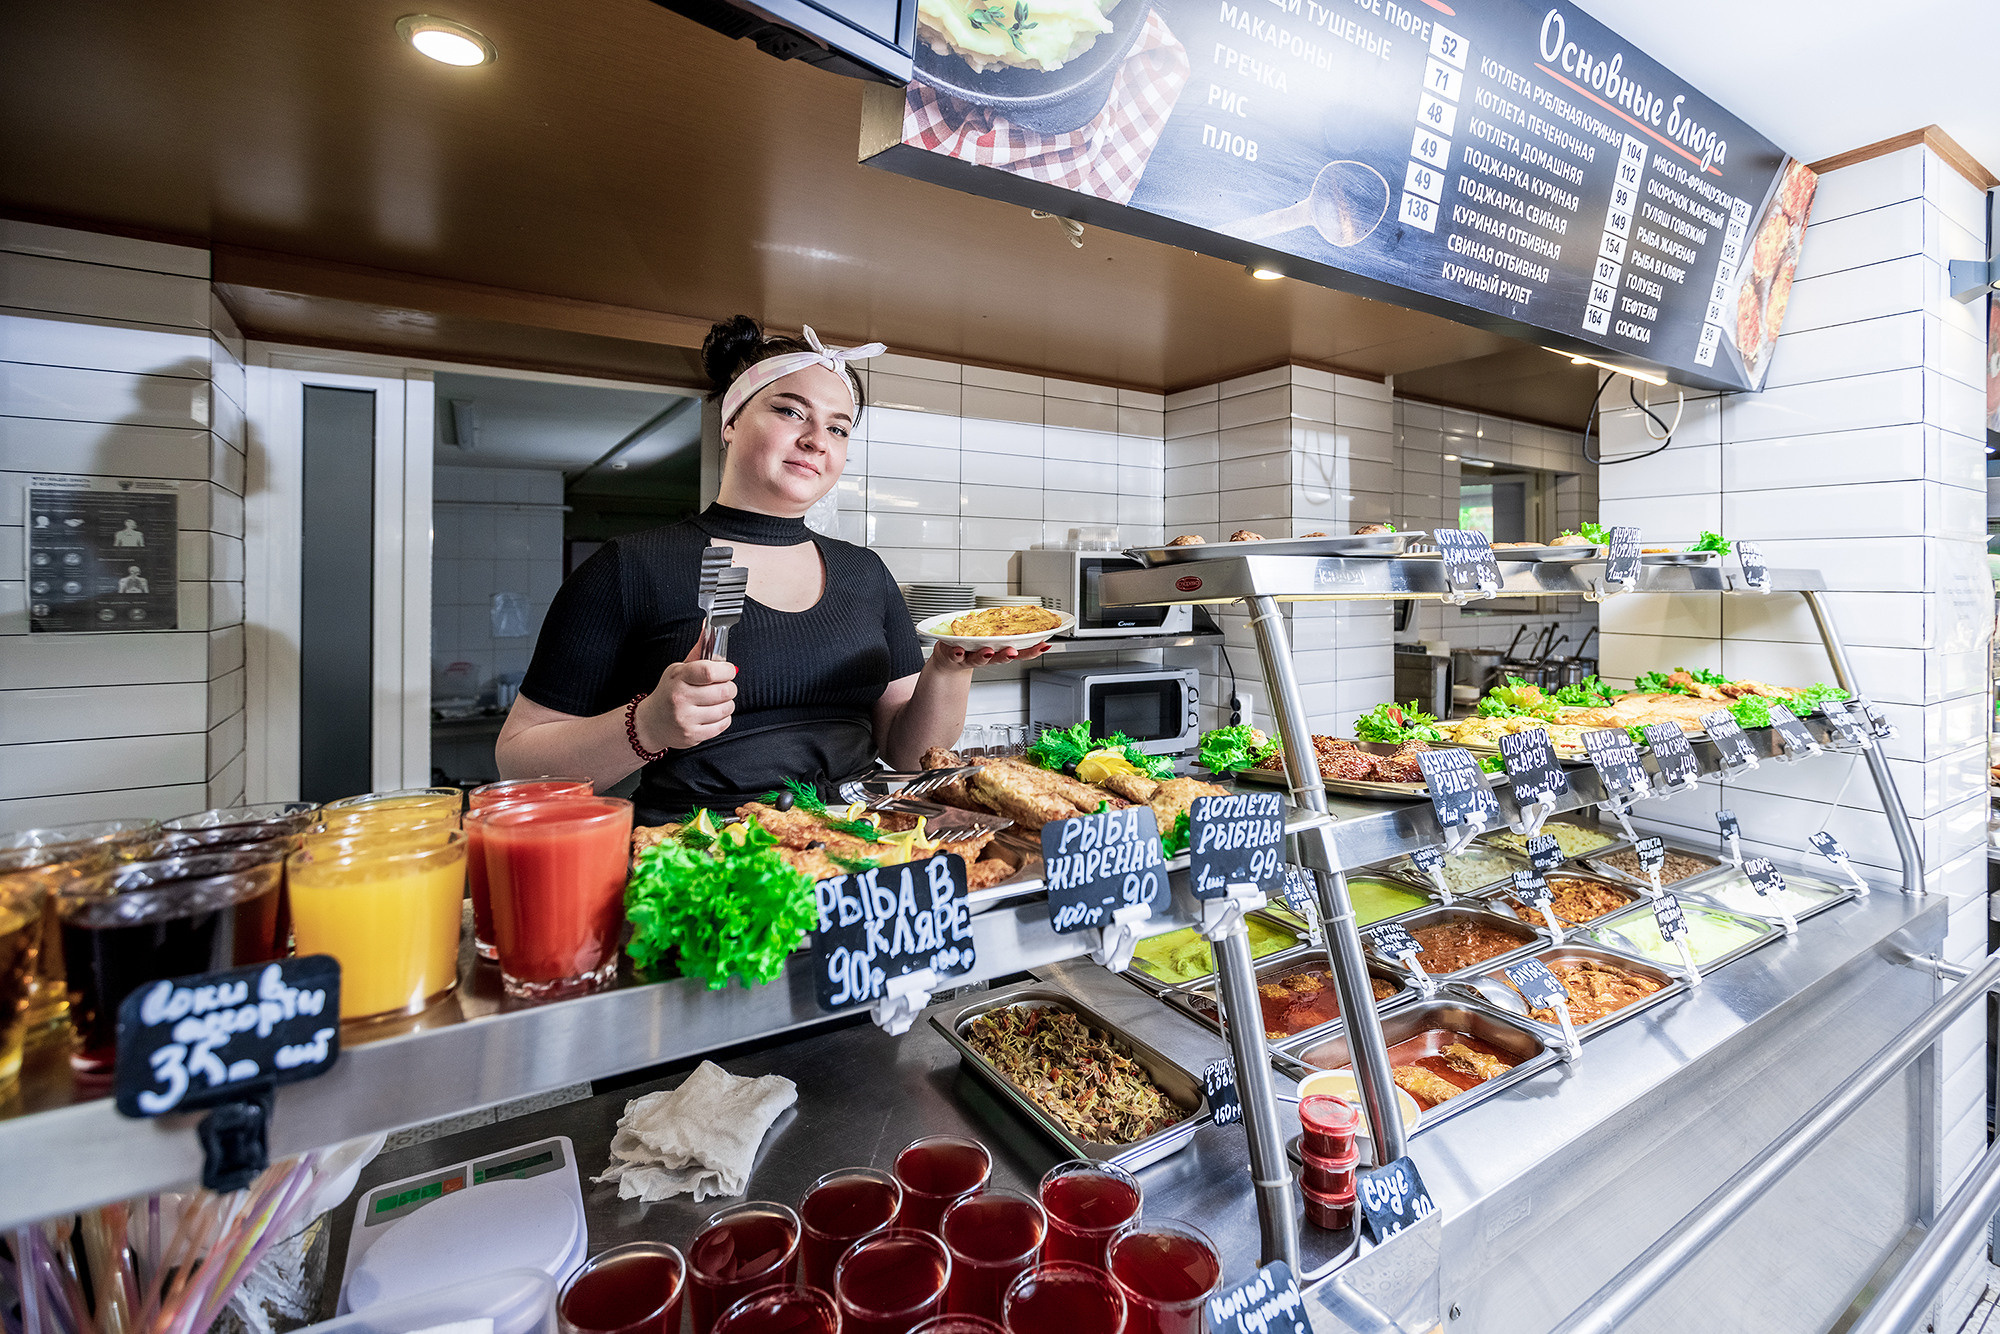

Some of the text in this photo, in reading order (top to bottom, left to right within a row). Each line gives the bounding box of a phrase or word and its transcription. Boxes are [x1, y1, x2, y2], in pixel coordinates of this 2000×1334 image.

[1306, 0, 1393, 61] ТУШЕНЫЕ
[1434, 68, 1450, 91] 71
[1384, 1, 1432, 43] ПЮРЕ
[1440, 34, 1458, 59] 52
[1219, 1, 1443, 124] МАКАРОНЫ 48
[1539, 8, 1727, 172] Основные блюда
[1214, 43, 1437, 158] ГРЕЧКА 49
[1480, 55, 1642, 163] КОТЛЕТА РУБЛЕНАЯ КУРИНАЯ 104
[1208, 83, 1431, 190] РИС 49
[1469, 116, 1628, 206] КОТЛЕТА ДОМАШНЯЯ 99
[1475, 86, 1636, 184] КОТЛЕТА ПЕЧЕНОЧНАЯ 112
[1202, 124, 1429, 221] ПЛОВ 138
[1463, 146, 1626, 231] ПОДЖАРКА КУРИНАЯ 149
[1647, 179, 1690, 214] ОКОРОЧОК
[1687, 199, 1725, 230] ЖАРЕНЫЙ
[1652, 154, 1676, 179] МЯСО
[1675, 165, 1734, 210] ПО-ФРАНЦУЗСКИ
[1452, 204, 1614, 281] КУРИНАЯ ОТБИВНАЯ 137
[1458, 175, 1621, 255] ПОДЖАРКА СВИНАЯ 154
[1636, 226, 1660, 249] РЫБА
[1659, 236, 1697, 265] ЖАРЕНАЯ
[1641, 202, 1672, 226] ГУЛЯШ
[1669, 217, 1708, 246] ГОВЯЖИЙ
[1441, 261, 1602, 327] КУРИНЫЙ РУЛЕТ 164
[1447, 233, 1609, 305] СВИНАЯ ОТБИВНАЯ 146
[1625, 273, 1664, 302] ГОЛУБЕЦ
[1631, 250, 1655, 272] РЫБА
[1653, 259, 1662, 274] В
[1660, 262, 1686, 284] КЛЯРЕ
[1615, 320, 1651, 344] СОСИСКА
[1621, 296, 1659, 322] ТЕФТЕЛЯ
[1196, 794, 1281, 822] КОТЛЕТА
[1434, 767, 1479, 797] РУЛЕТ
[1058, 806, 1140, 855] РЫБА
[1196, 818, 1282, 855] РЫБНАЯ
[814, 855, 955, 933] РЫБА В
[1046, 837, 1162, 892] ЖАРЕНАЯ
[1122, 872, 1159, 909] 90
[863, 898, 974, 962] КЛЯРЕ
